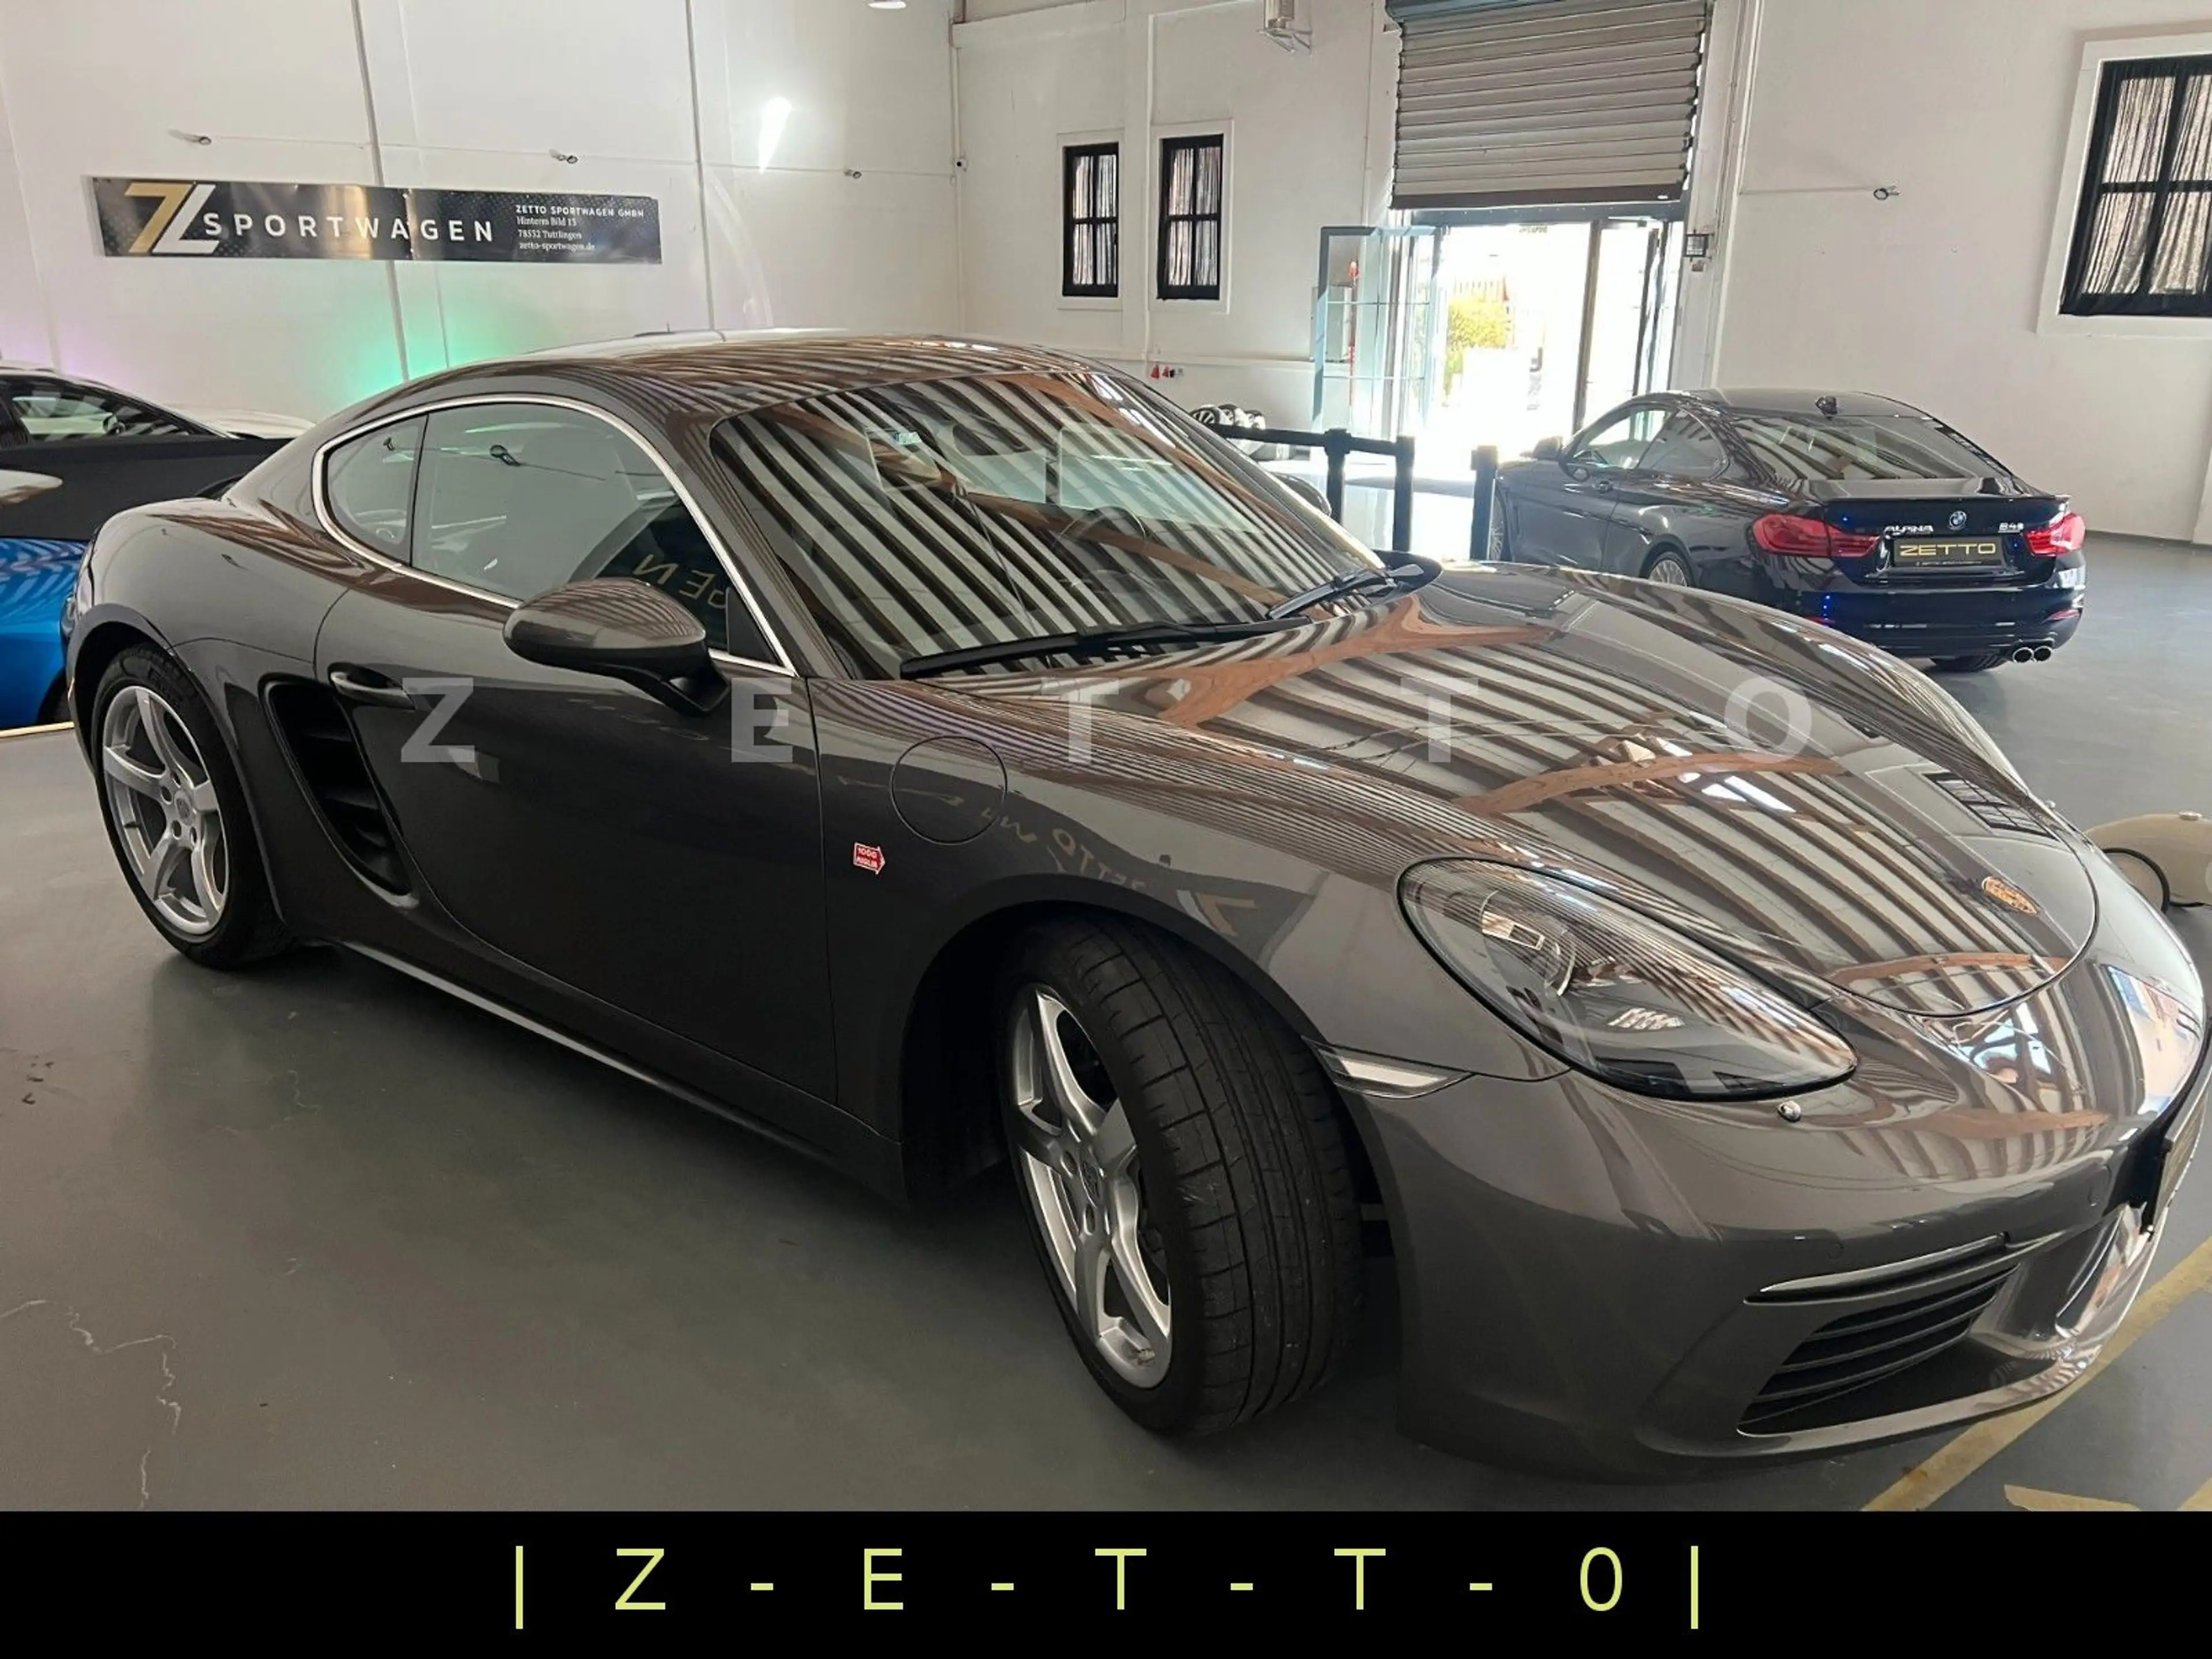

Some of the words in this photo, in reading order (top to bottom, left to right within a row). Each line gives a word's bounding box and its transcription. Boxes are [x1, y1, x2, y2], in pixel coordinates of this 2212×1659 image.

[516, 204, 547, 215] ZETTO
[550, 206, 614, 217] SPORTWAGEN
[203, 213, 493, 242] SPORTWAGEN
[1900, 543, 1996, 556] ZETTO
